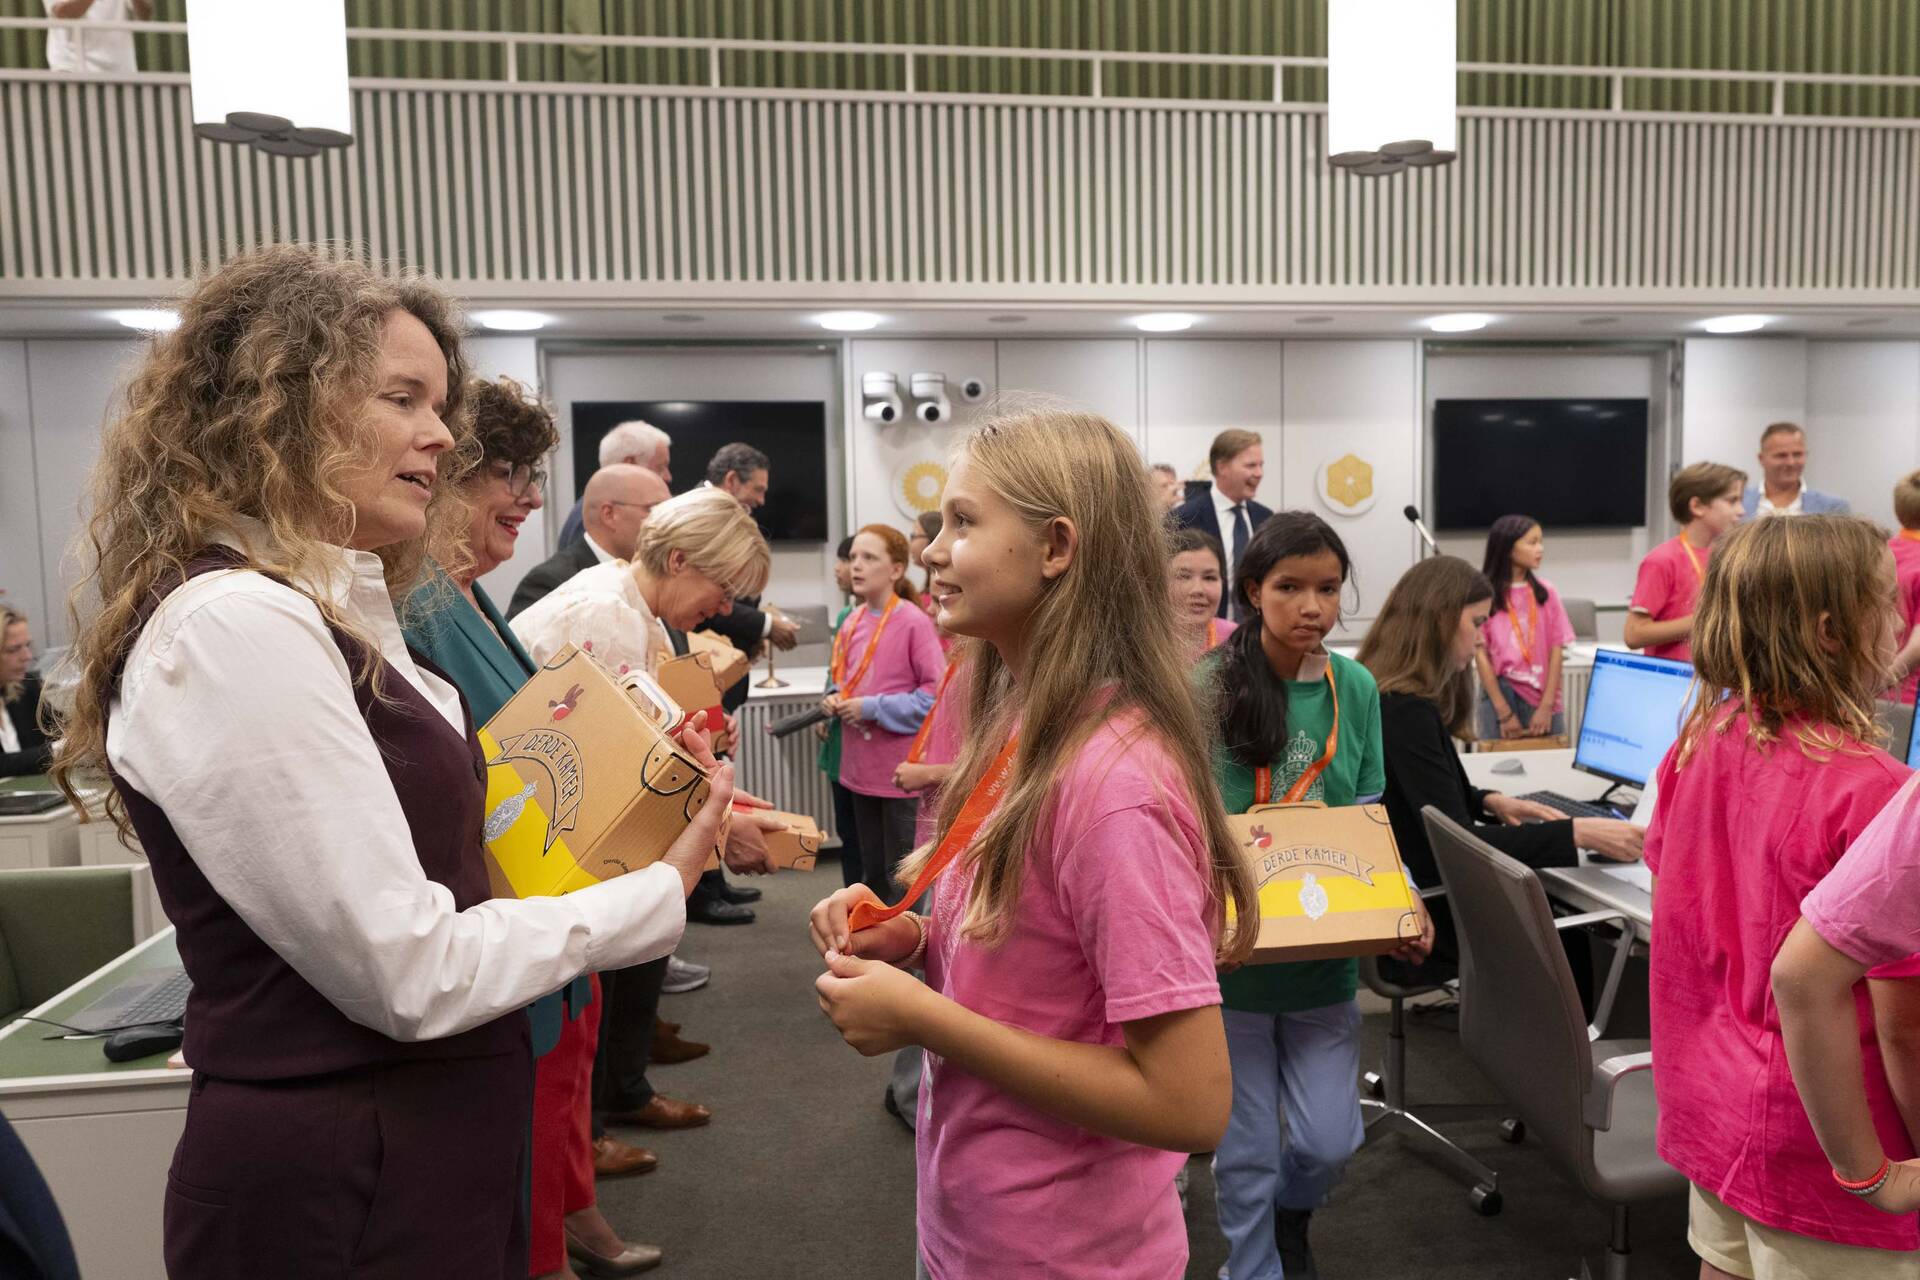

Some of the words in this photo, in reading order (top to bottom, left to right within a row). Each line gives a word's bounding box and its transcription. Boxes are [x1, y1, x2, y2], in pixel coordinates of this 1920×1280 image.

[522, 734, 566, 760] DERDE
[555, 749, 579, 807] KAMER
[1263, 848, 1300, 873] DERDE
[1304, 847, 1347, 867] KAMER
